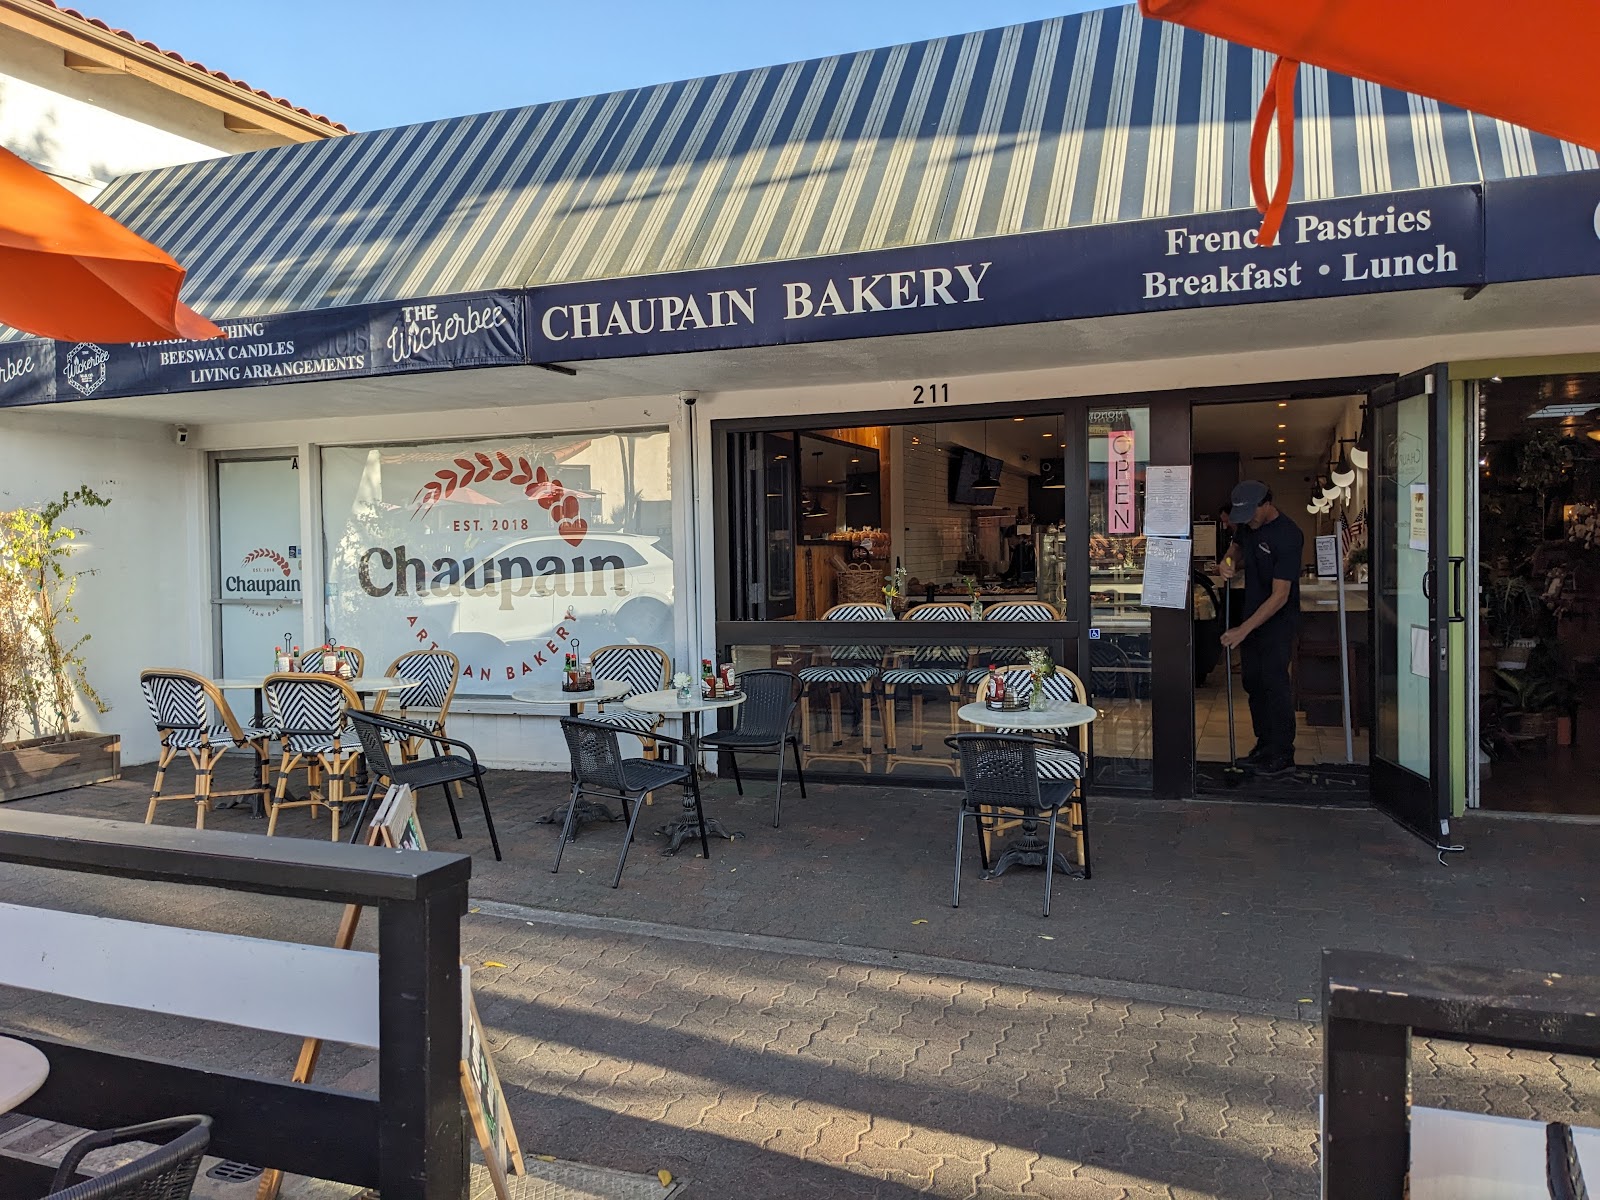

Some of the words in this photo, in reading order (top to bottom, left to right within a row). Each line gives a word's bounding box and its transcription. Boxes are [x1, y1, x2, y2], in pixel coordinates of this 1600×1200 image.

[1165, 220, 1281, 257] Frenc
[1295, 205, 1432, 244] Pastries
[1142, 259, 1302, 299] Breakfast
[1342, 244, 1458, 282] Lunch
[402, 304, 438, 322] THE
[541, 287, 757, 342] CHAUPAIN
[783, 261, 993, 320] BAKERY
[160, 346, 225, 366] BEESWAX
[228, 340, 295, 359] CANDLES
[387, 305, 507, 363] Wickerbee
[191, 366, 240, 384] LIVING
[243, 355, 365, 379] ARRANGEMENTS
[912, 383, 950, 405] 211
[291, 457, 299, 470] A
[1112, 434, 1132, 530] OPEN
[453, 520, 483, 532] EST.
[492, 519, 529, 531] 2018
[226, 576, 301, 595] Chaupain
[358, 545, 630, 611] Chaupain
[406, 616, 491, 682] ARTAN
[506, 609, 577, 680] BAKERY
